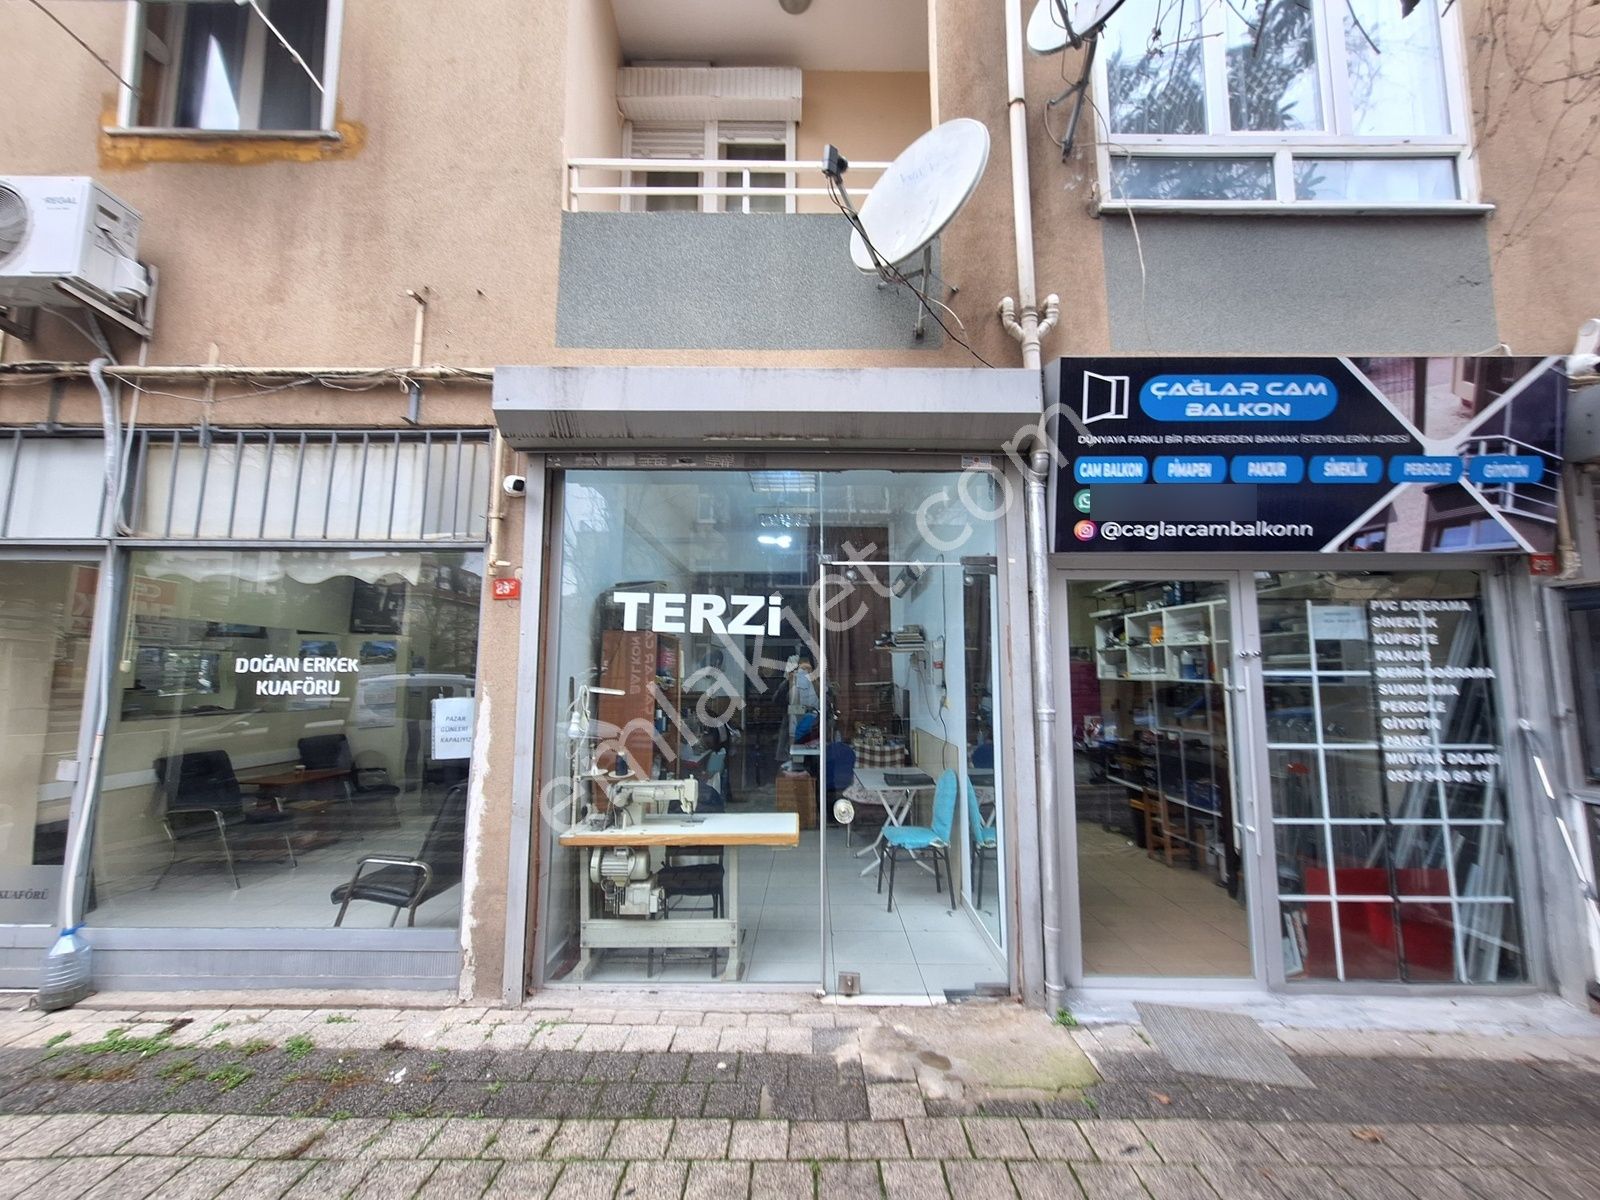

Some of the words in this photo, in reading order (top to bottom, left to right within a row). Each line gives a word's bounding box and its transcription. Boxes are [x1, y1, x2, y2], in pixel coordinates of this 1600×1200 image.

[1150, 379, 1259, 400] ÇAĞLAR
[1265, 381, 1327, 396] CAM
[1185, 402, 1290, 417] BALKON
[1078, 434, 1126, 444] DÜNYAYA
[1127, 434, 1163, 444] FARKLI
[1165, 433, 1183, 444] BİR
[1184, 434, 1254, 444] PENCEREDEN
[1255, 434, 1299, 444] BAKMAK
[1079, 462, 1102, 477] CAM
[1103, 462, 1143, 477] BALKON
[1167, 457, 1212, 477] PİMAPEN
[1403, 462, 1452, 476] PERGOLE
[1101, 520, 1313, 540] @caglarcambalkonn
[1370, 600, 1399, 611] PVC
[1374, 650, 1432, 662] PANJUR
[235, 654, 299, 673] DOĞAN
[303, 658, 359, 672] ERKEK
[1378, 684, 1460, 696] SUNDURMA
[1380, 701, 1447, 713] PERGOLE
